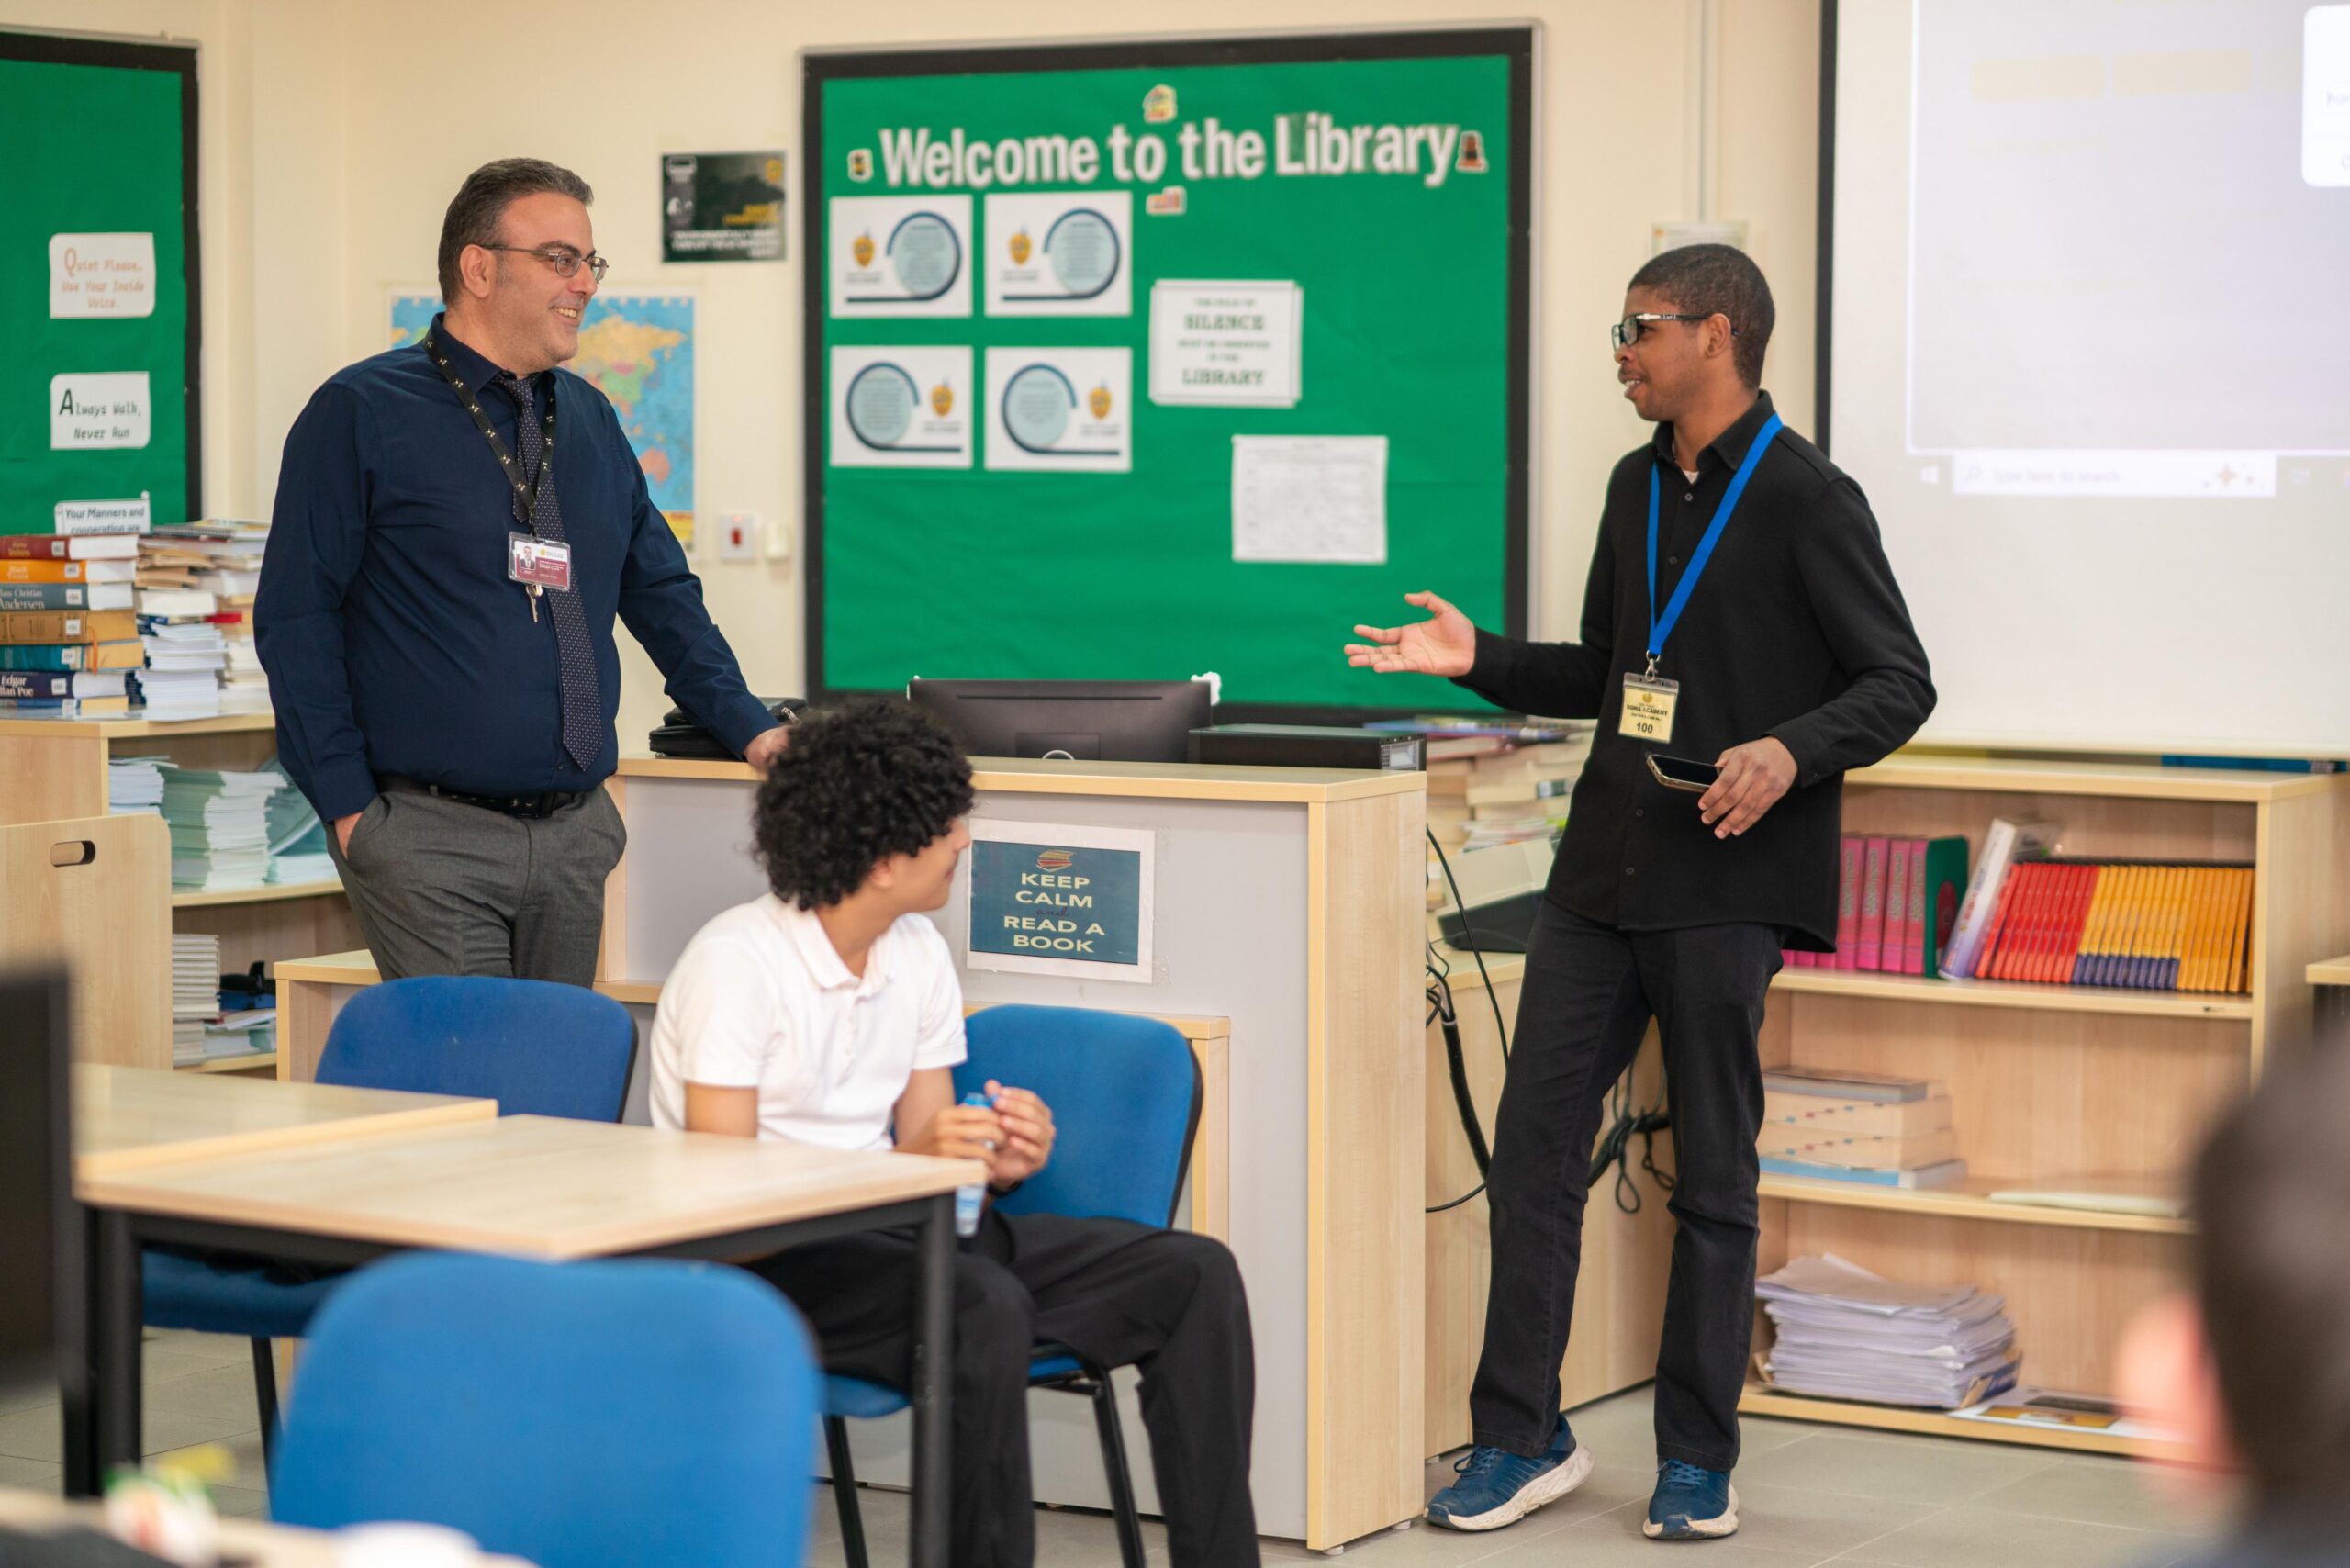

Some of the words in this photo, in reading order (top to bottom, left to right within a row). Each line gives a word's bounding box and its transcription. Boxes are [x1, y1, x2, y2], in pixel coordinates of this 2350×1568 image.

[879, 127, 1100, 187] Welcome
[1107, 123, 1168, 185] to
[1178, 116, 1267, 179] the
[1275, 111, 1461, 187] Library
[63, 247, 98, 278] Quiet
[85, 280, 107, 293] Your
[112, 279, 145, 293] Inside
[1183, 314, 1265, 330] SILENCE
[1181, 367, 1265, 386] LIBRARY
[59, 388, 107, 419] Always
[73, 427, 107, 440] Never
[112, 425, 131, 439] Run
[65, 508, 87, 520] Your
[87, 505, 128, 519] Manners
[129, 504, 146, 518] and
[14, 587, 44, 599] Christian
[1, 673, 28, 689] Edgar
[17, 687, 35, 698] Poe
[1636, 722, 1654, 734] 100
[1021, 872, 1091, 890] KEEP
[1014, 890, 1093, 908] CALM
[1036, 905, 1068, 916] and
[1003, 915, 1078, 933] READ
[1084, 922, 1106, 936] A
[1013, 934, 1095, 954] BOOK
